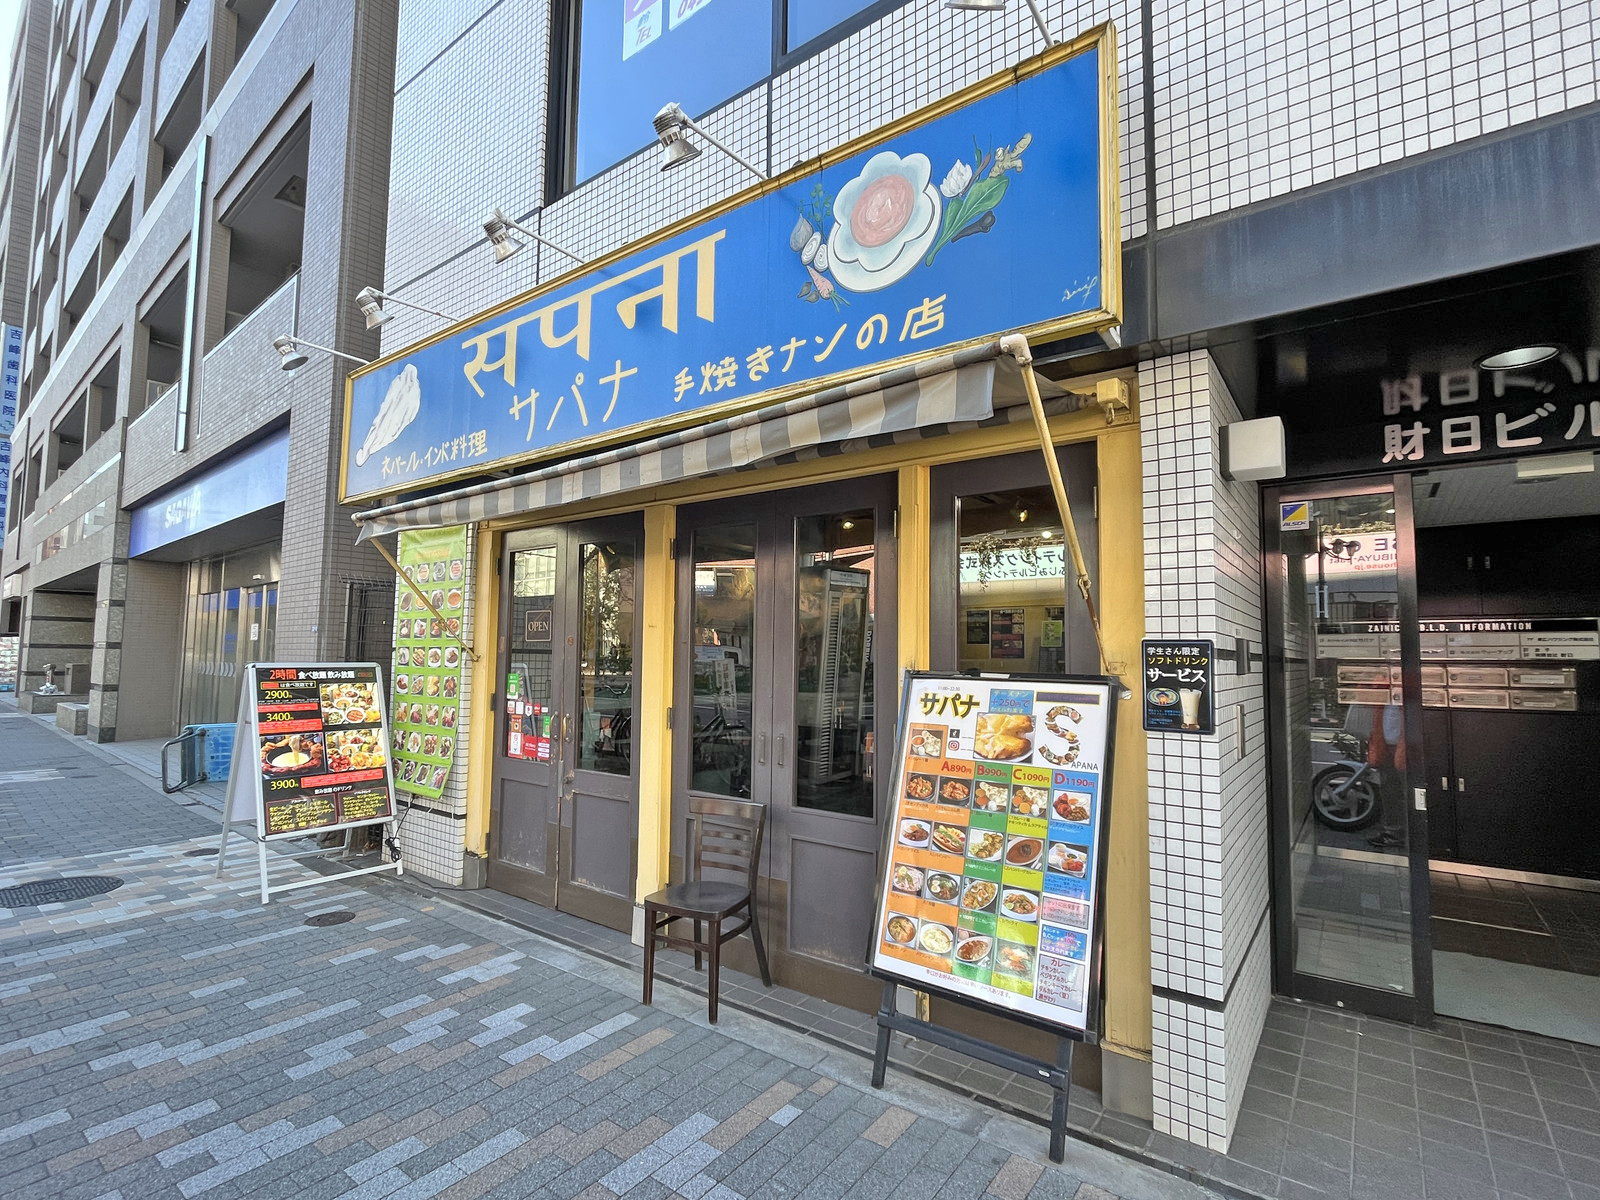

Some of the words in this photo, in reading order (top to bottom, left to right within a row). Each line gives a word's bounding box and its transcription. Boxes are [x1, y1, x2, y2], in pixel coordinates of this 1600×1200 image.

[636, 26, 651, 46] TEL
[462, 229, 726, 398] सपना
[673, 293, 947, 403] 手焼きナンの店
[3, 328, 22, 417] 吉峰歯科医院
[509, 359, 638, 442] サパナ
[528, 621, 549, 632] OPEN
[1460, 622, 1532, 631] INFORMATION
[1147, 647, 1200, 656] 学生さん限定
[1148, 657, 1208, 665] ソフトドリンク
[269, 669, 297, 680] 2時間
[1147, 668, 1206, 682] サービス
[920, 692, 980, 719] サパナ
[1071, 761, 1099, 771] APANA
[1050, 959, 1071, 968] カレー
